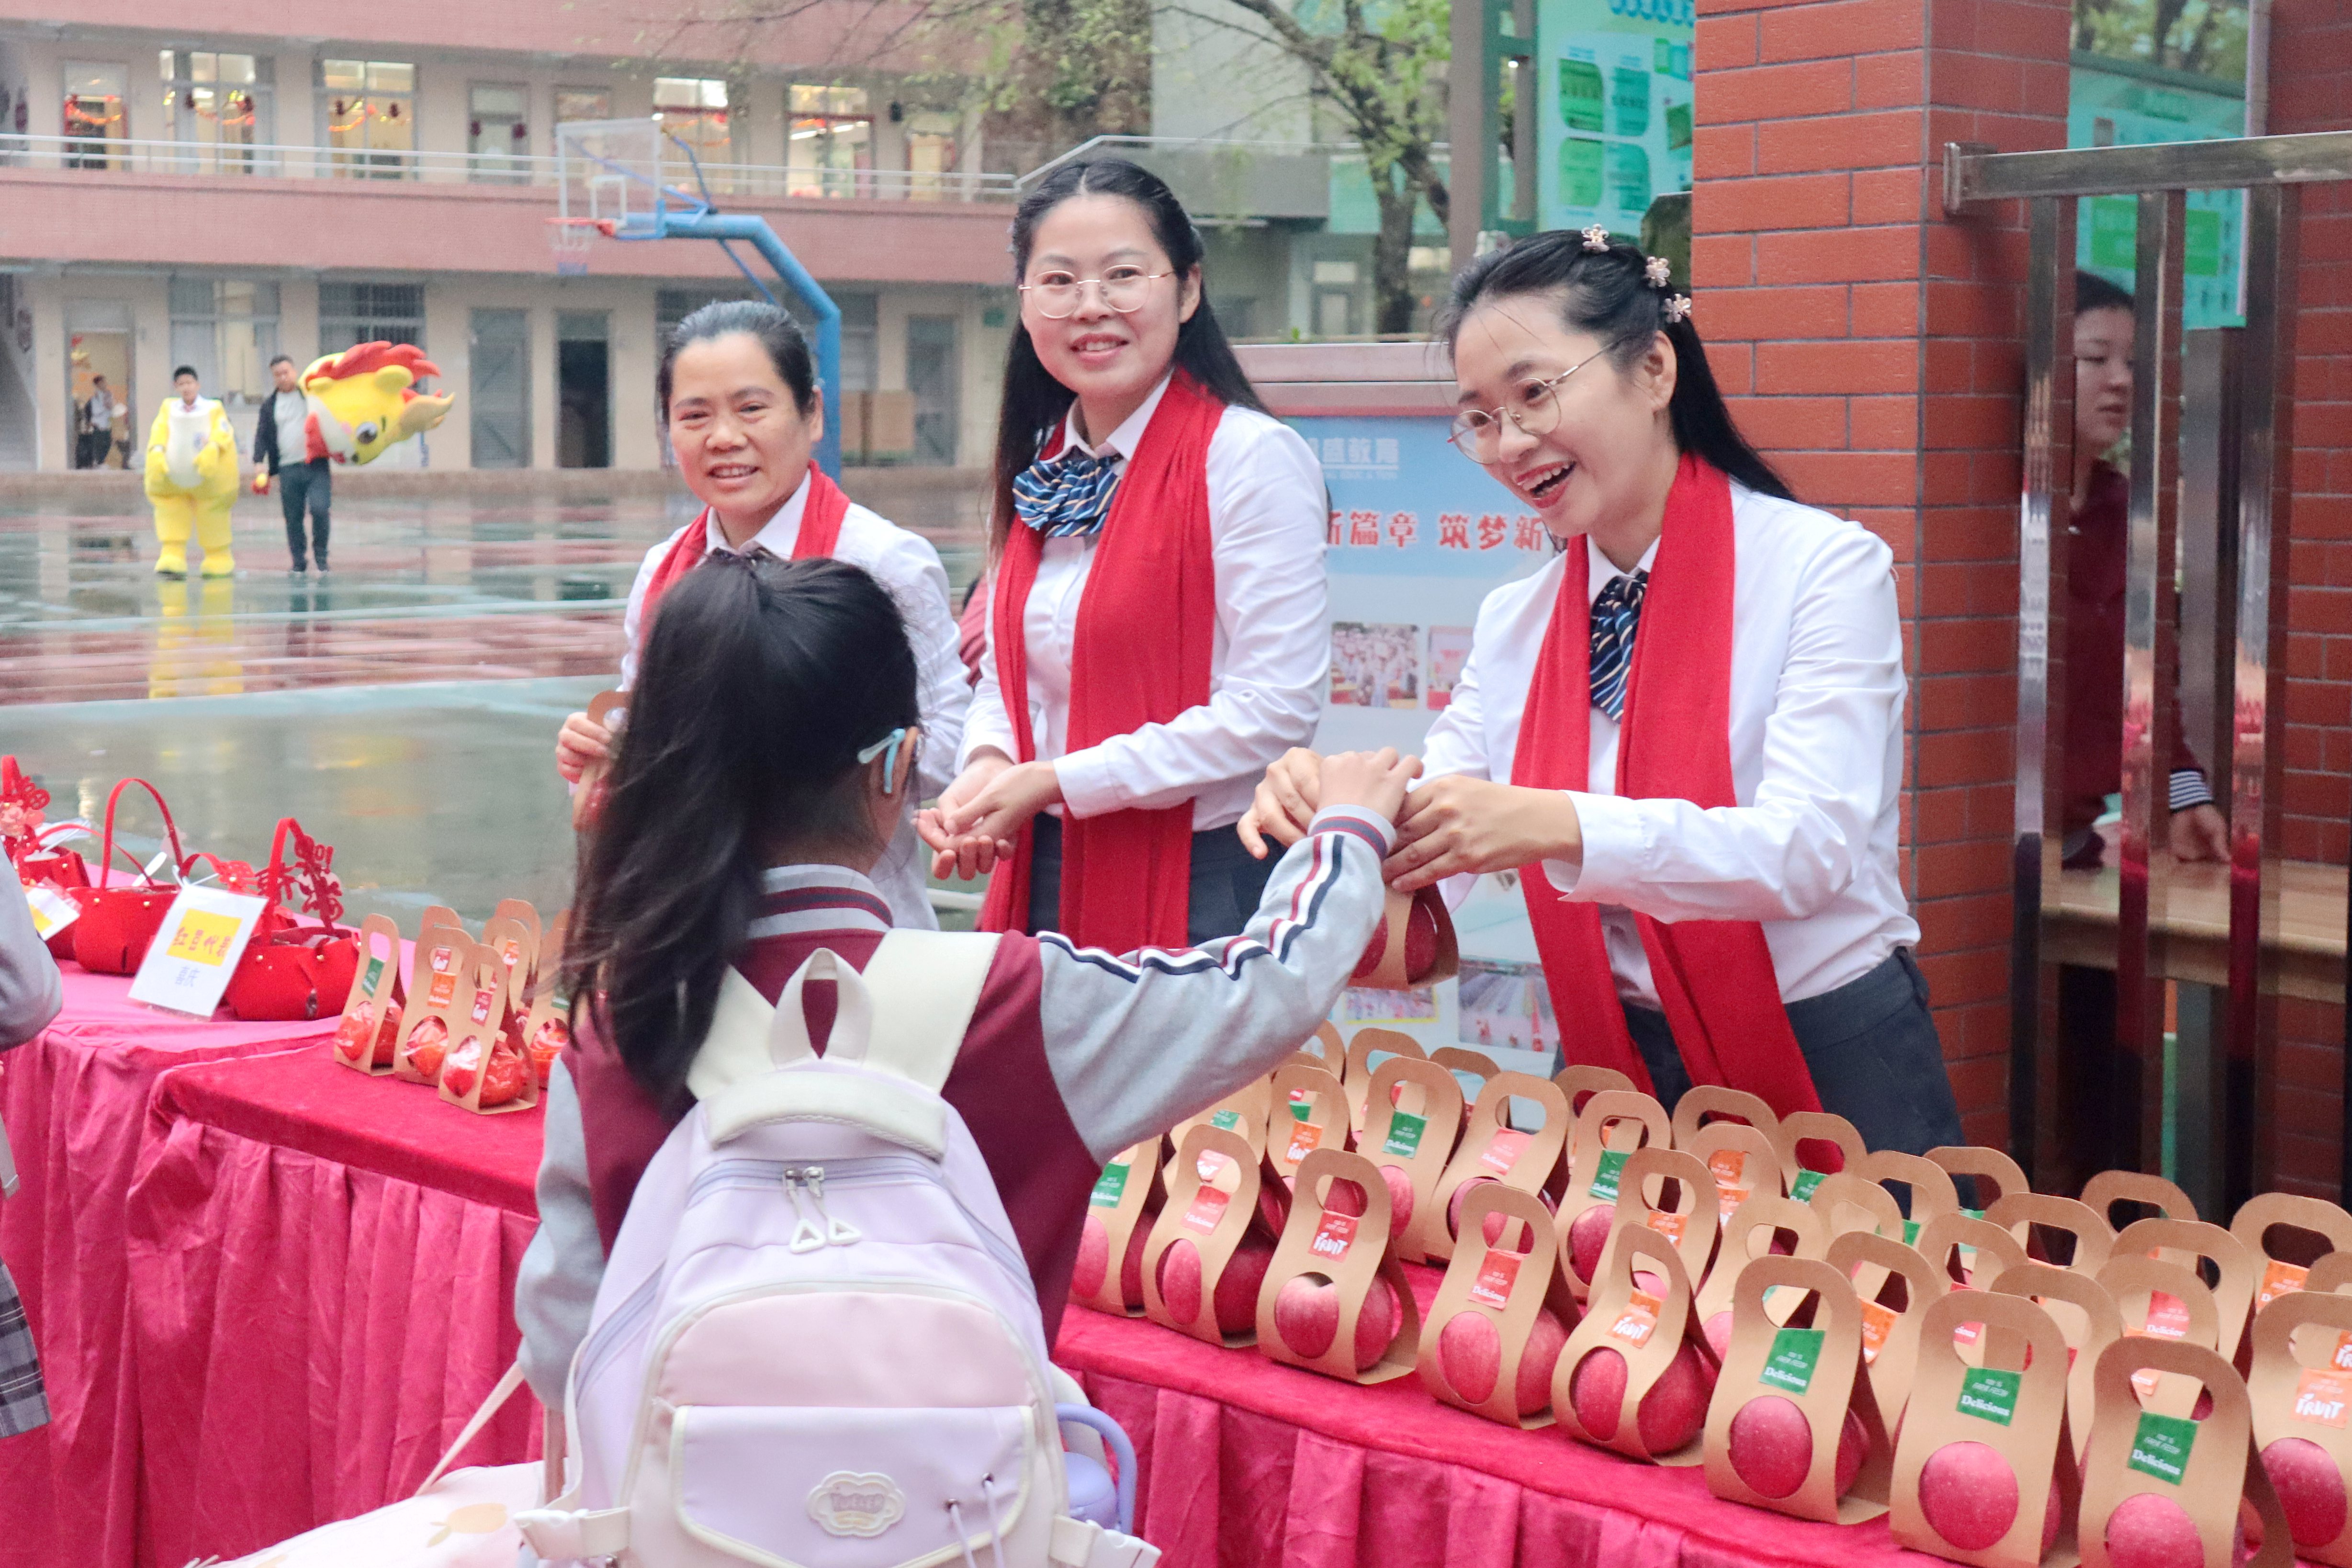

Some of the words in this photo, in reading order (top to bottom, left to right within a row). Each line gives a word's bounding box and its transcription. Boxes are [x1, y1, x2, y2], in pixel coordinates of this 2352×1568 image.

[1440, 514, 1542, 551] 筑梦新
[1313, 1232, 1348, 1255] FRUIT
[1471, 1286, 1507, 1302] Delicious
[1612, 1316, 1650, 1339] FRUIT
[1764, 1366, 1808, 1387] Delicious
[1961, 1395, 2010, 1417] Delicious
[2295, 1393, 2345, 1419] FRUIT
[2132, 1448, 2181, 1476] Delicious
